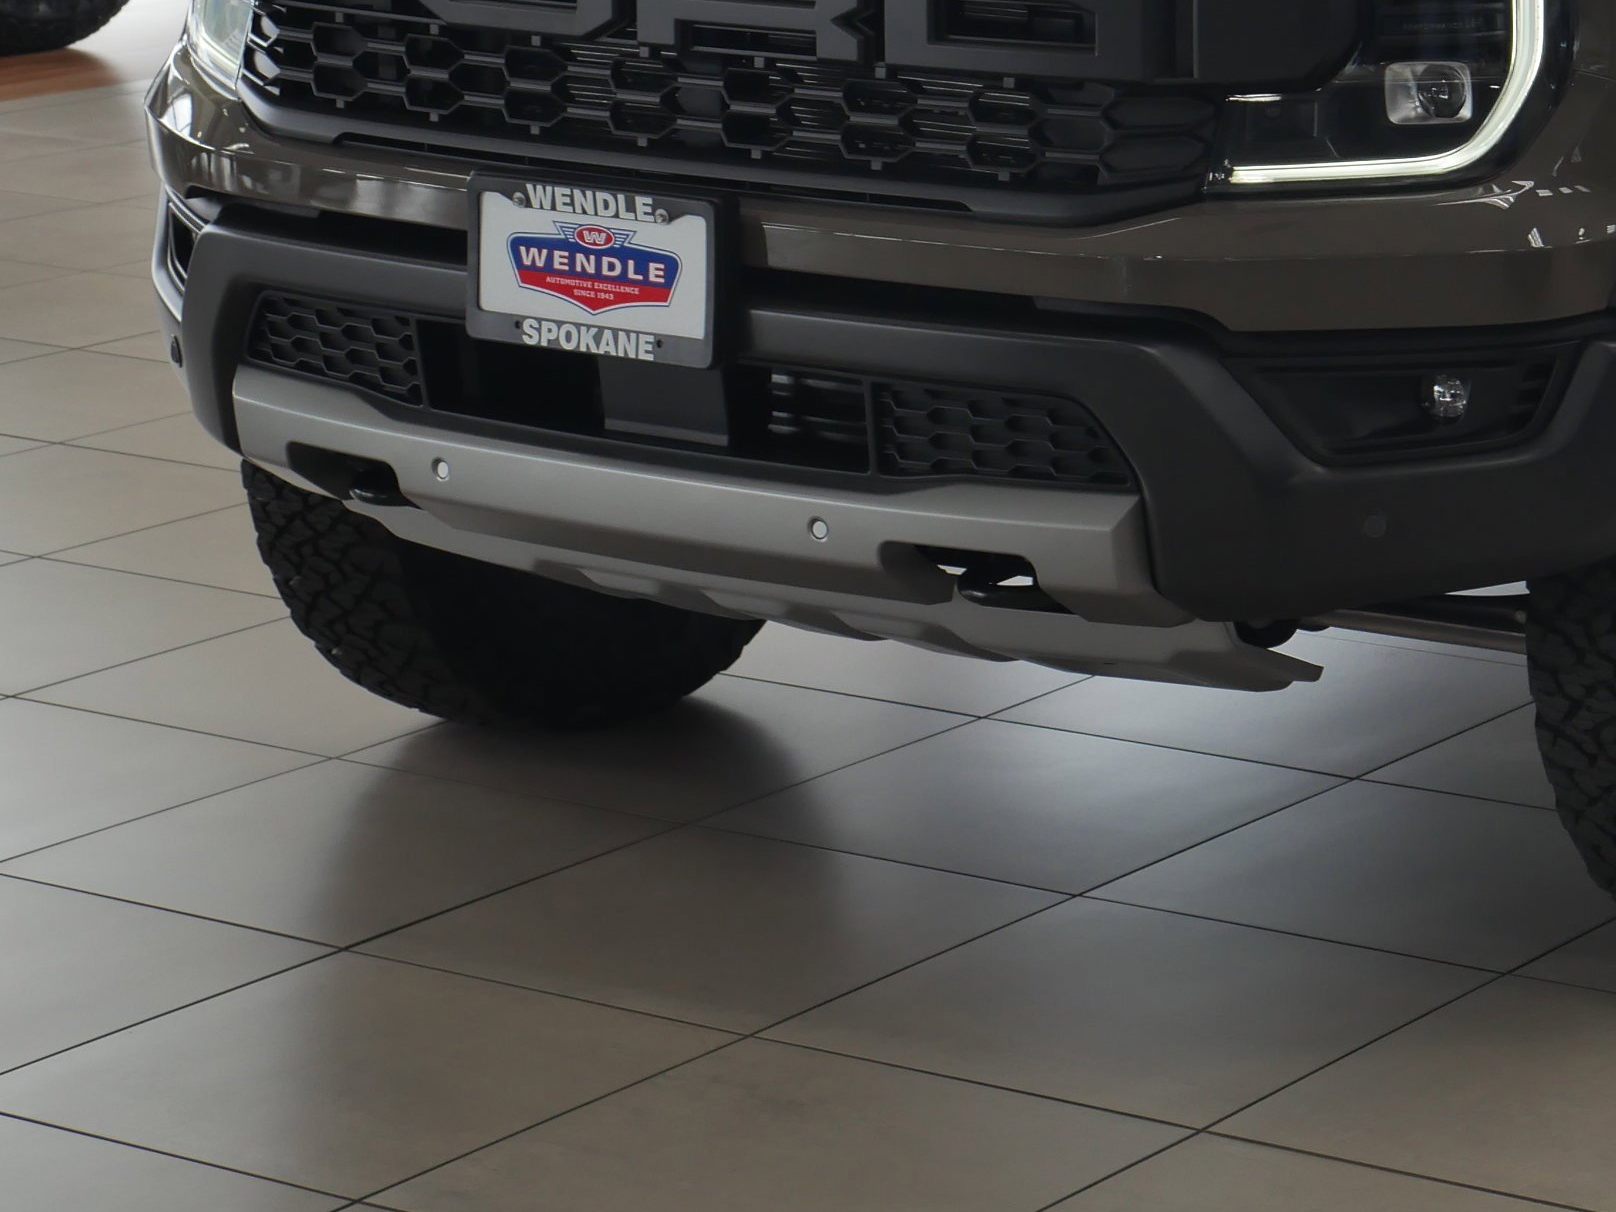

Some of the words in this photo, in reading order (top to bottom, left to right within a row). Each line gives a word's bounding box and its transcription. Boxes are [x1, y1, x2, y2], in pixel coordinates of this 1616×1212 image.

[525, 183, 657, 223] WENDLE
[519, 245, 665, 283] WENDLE
[546, 276, 593, 289] AUTOMOTIVE
[594, 281, 640, 295] EXCELLENCE
[573, 289, 596, 299] SINCE
[597, 291, 615, 301] 1943
[522, 318, 656, 361] SPOKANE
